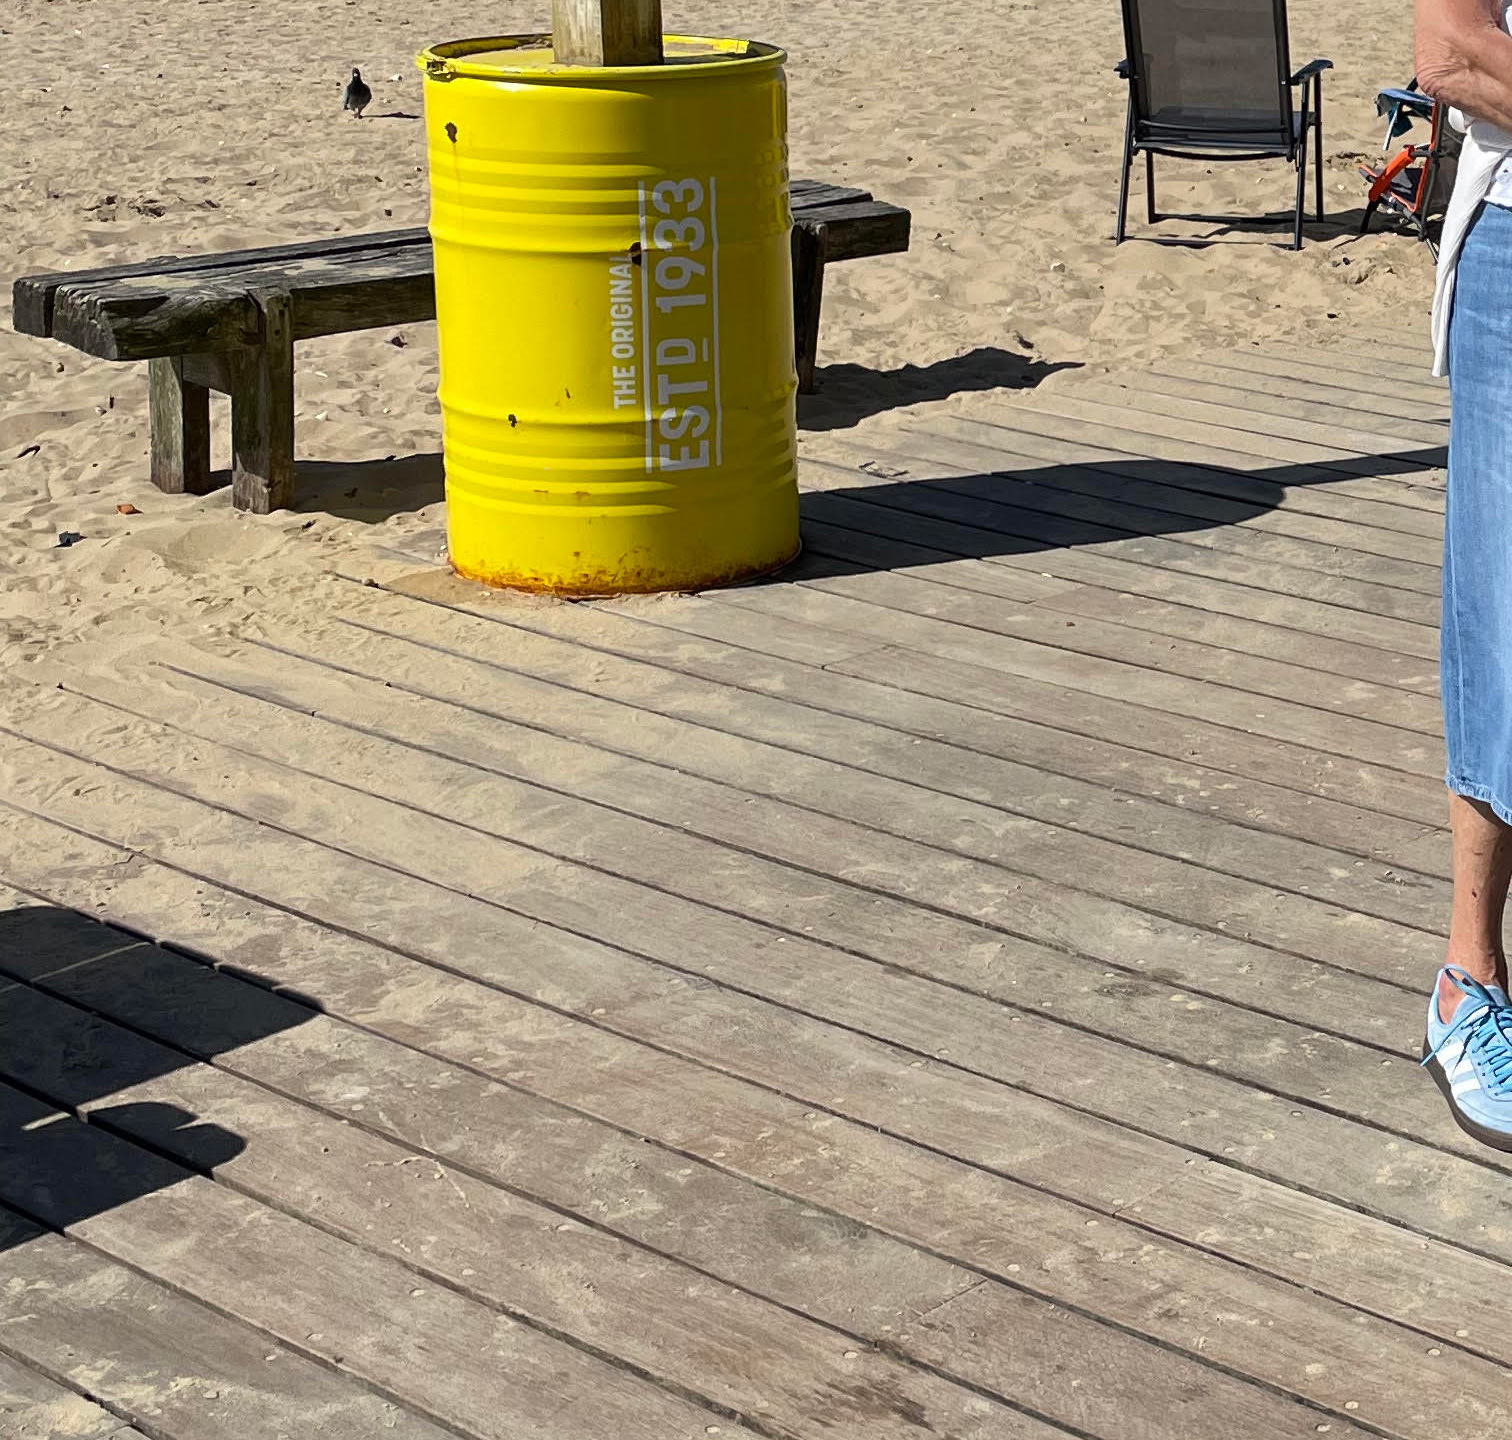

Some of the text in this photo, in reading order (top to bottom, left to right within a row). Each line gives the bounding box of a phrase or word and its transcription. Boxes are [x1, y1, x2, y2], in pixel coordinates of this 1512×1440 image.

[610, 254, 637, 409] THE ORIGINAL
[653, 178, 710, 472] ESTD 1933
